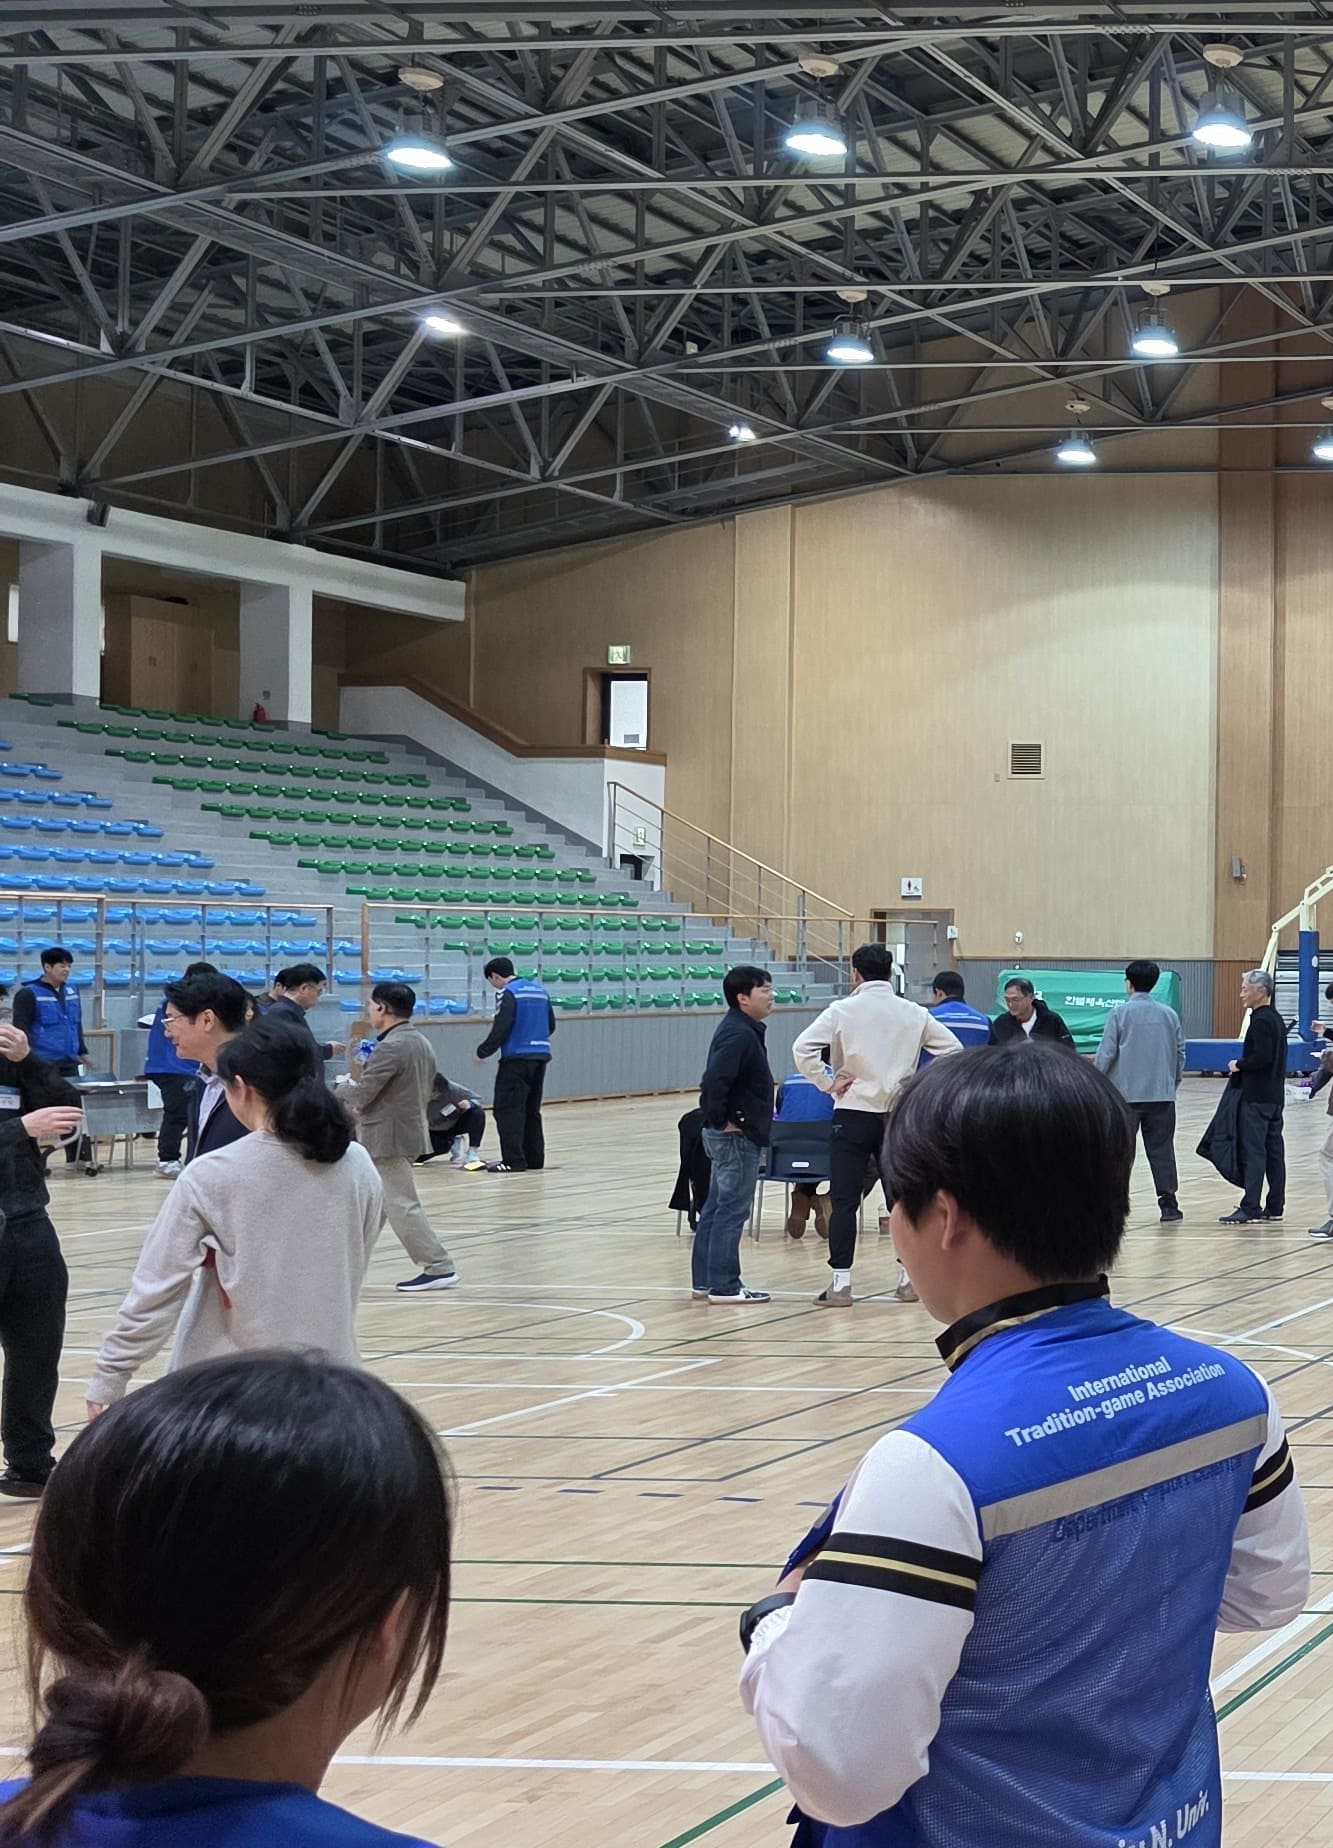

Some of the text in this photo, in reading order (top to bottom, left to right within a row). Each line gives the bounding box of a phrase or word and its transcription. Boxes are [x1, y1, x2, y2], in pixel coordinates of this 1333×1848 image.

[1067, 1355, 1172, 1402] International
[1004, 1360, 1226, 1448] Tradition-game Association
[1175, 1789, 1209, 1839] Univ.
